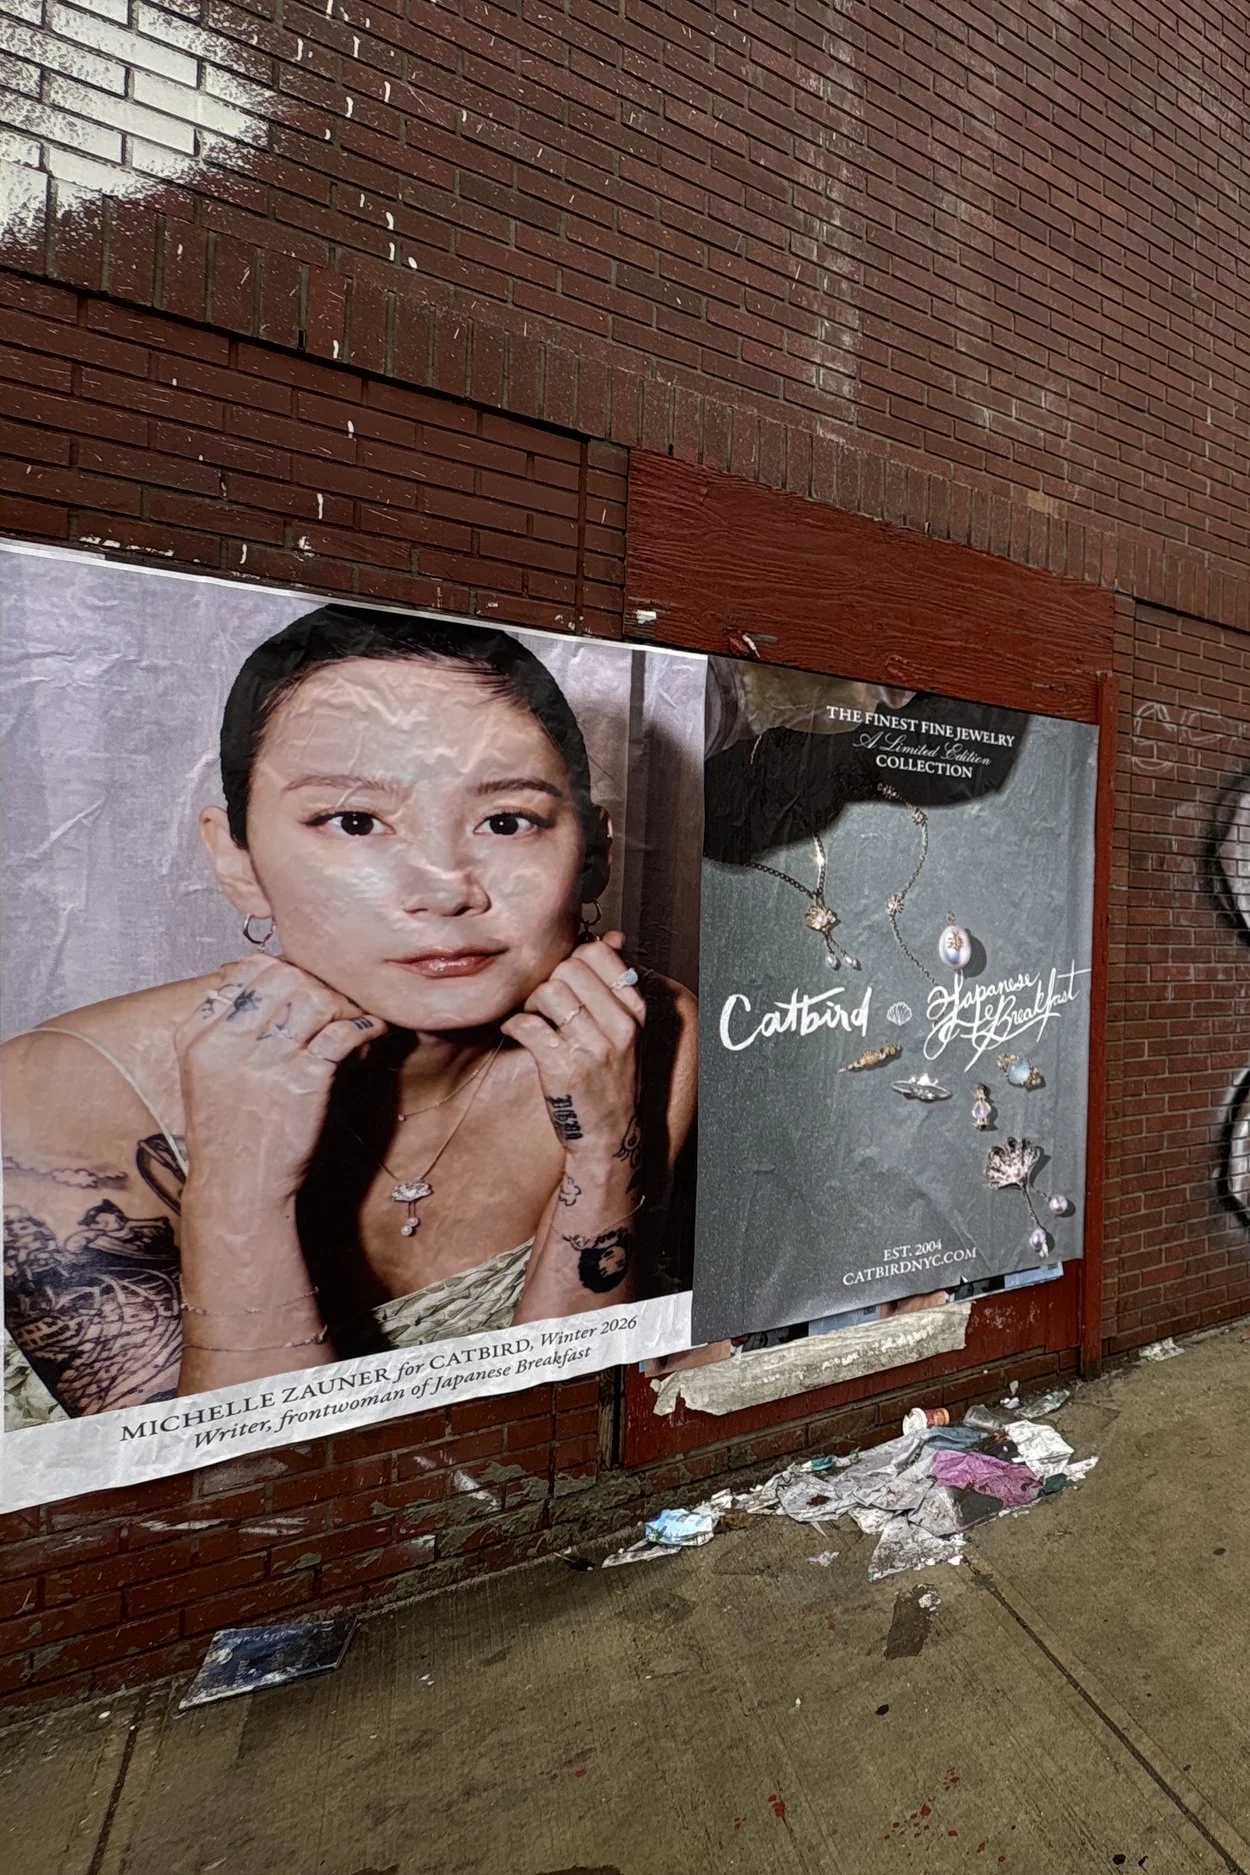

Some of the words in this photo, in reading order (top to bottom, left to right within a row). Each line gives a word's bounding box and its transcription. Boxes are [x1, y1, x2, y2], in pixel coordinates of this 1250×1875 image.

[827, 705, 863, 723] THE
[865, 712, 918, 733] FINEST
[921, 722, 954, 738] FINE
[955, 727, 1016, 748] JEWELRY
[852, 731, 884, 750] A
[879, 732, 941, 758] Limited
[941, 741, 992, 766] Edition
[875, 754, 974, 779] COLLECTION
[719, 987, 873, 1051] Catbird
[923, 971, 1040, 1060] Japanese
[964, 959, 1092, 1072] Breakfast
[842, 1247, 977, 1286] CATBIRDNYC.COM
[883, 1245, 912, 1262] EST.
[915, 1238, 943, 1256] 2004
[119, 1391, 276, 1442] MICHELLE
[281, 1367, 391, 1404] ZAUNER
[391, 1361, 425, 1383] for
[429, 1338, 534, 1370] CATBIRD,
[541, 1326, 598, 1346] Winter
[600, 1315, 638, 1336] 2026
[194, 1418, 273, 1449] Writer,
[273, 1388, 405, 1434] frontwoman
[411, 1377, 432, 1398] of
[431, 1366, 512, 1395] Japanese
[515, 1346, 592, 1375] Breakfast
